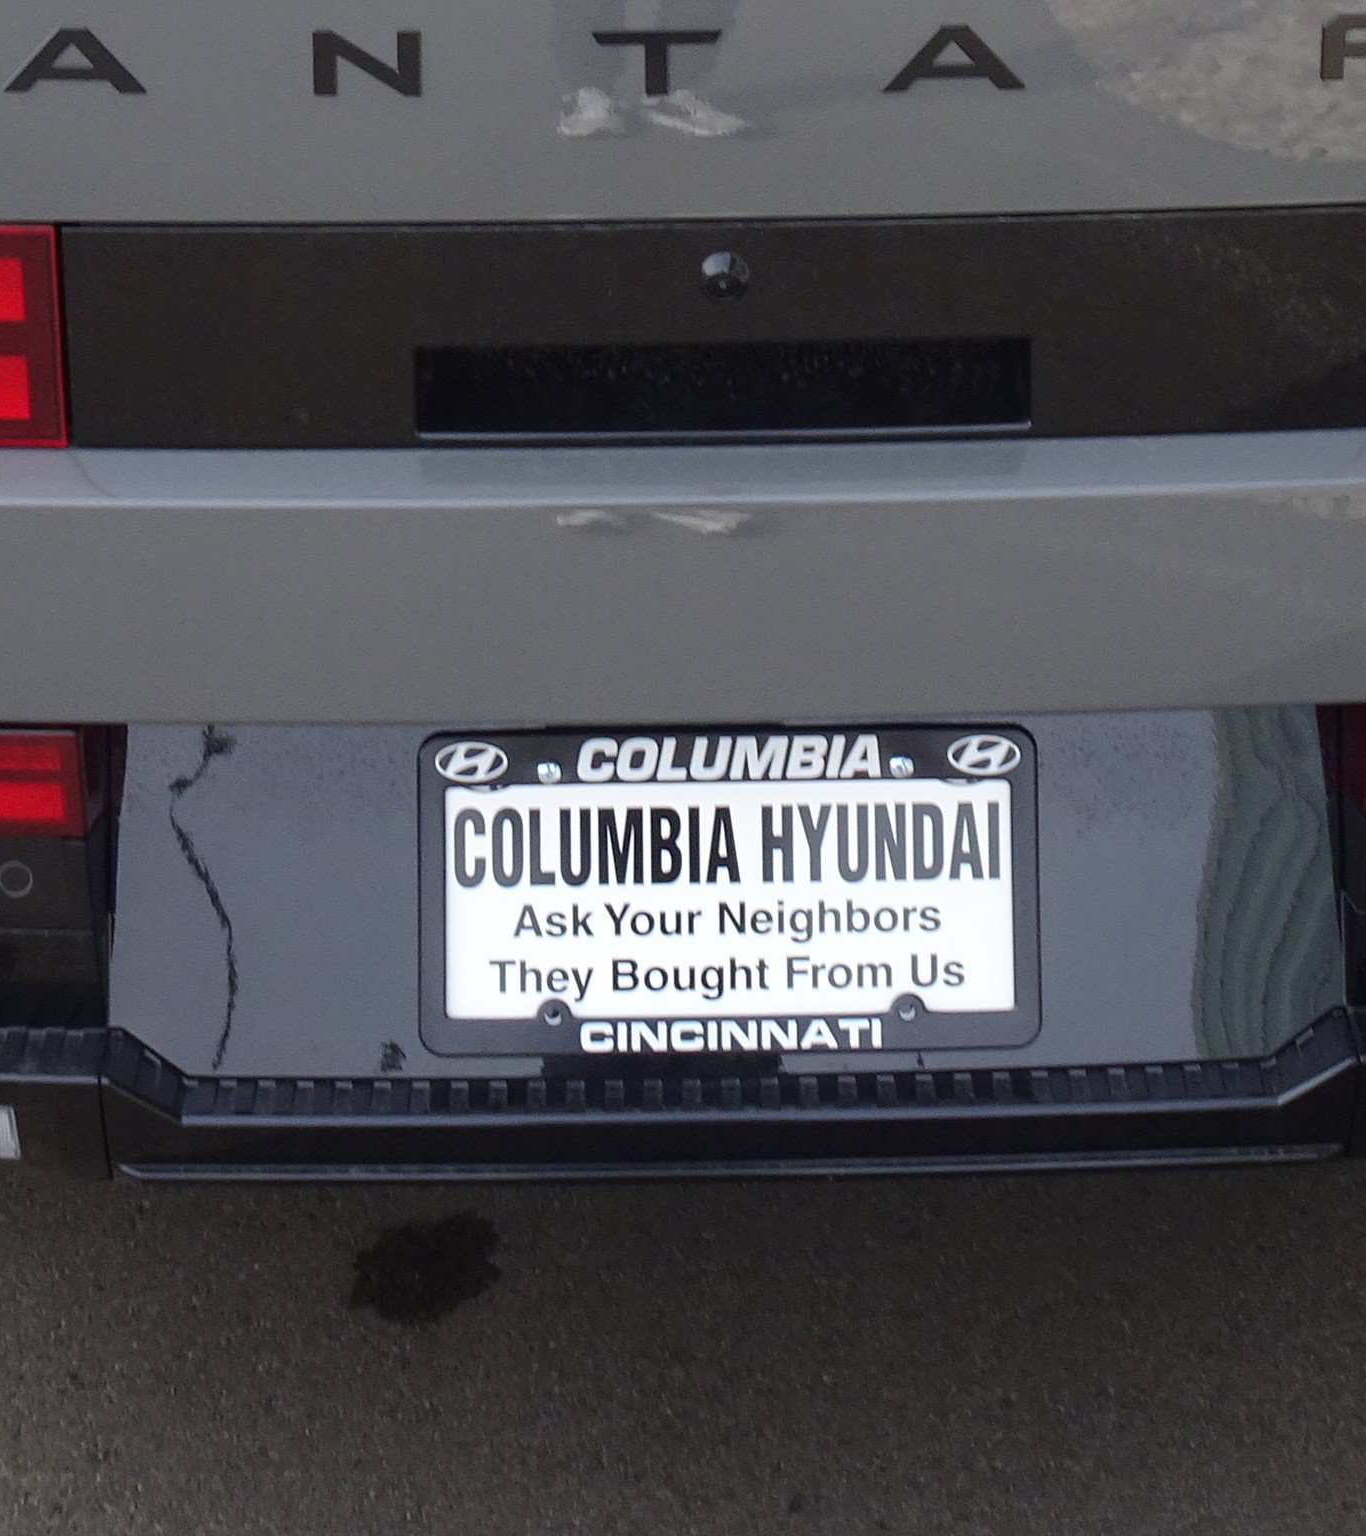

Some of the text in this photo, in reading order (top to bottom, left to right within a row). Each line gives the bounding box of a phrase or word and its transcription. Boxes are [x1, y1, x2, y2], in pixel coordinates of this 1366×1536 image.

[576, 734, 882, 782] COLUMBIA
[452, 800, 1003, 889] COLUMBIA HYUNDAI
[512, 899, 943, 943] Ask Your Neighbors
[488, 952, 967, 1002] They Bought From Us
[579, 1016, 884, 1054] CINCINNATI
